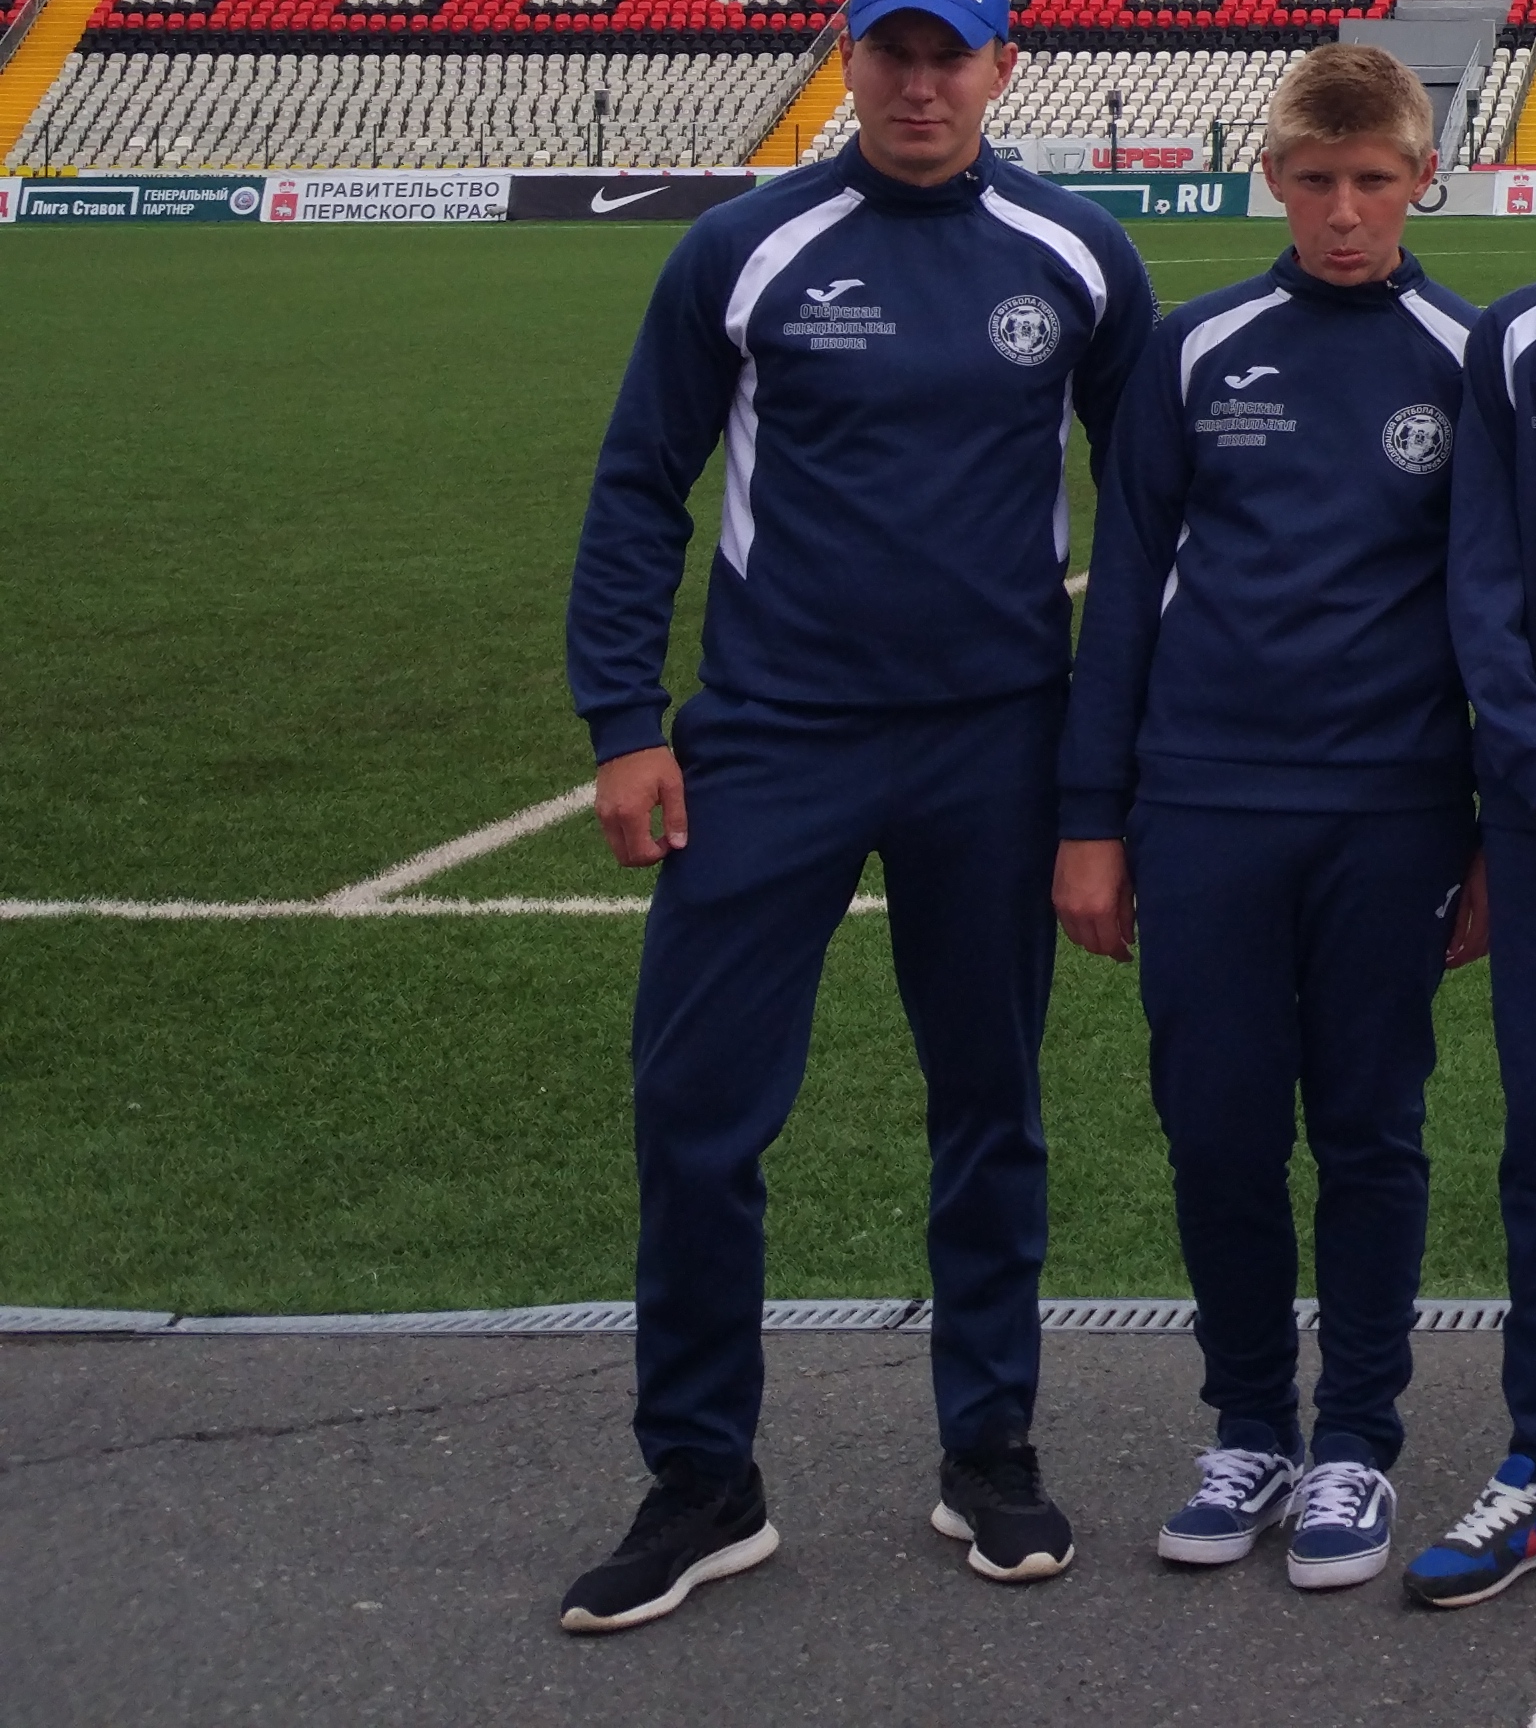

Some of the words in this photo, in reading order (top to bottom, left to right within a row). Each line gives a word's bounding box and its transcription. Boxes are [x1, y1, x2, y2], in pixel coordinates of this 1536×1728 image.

[1092, 147, 1194, 170] ЦЕРБЕР
[144, 187, 230, 201] ГЕНЕРАЛЬНЫЙ
[305, 182, 500, 198] ПРАВИТЕЛЬСТВО
[31, 200, 69, 216] Лига
[72, 199, 126, 216] Ставок
[142, 203, 195, 216] ПАРТНЕР
[303, 203, 436, 220] ПЕРМСКОГО
[800, 302, 881, 321] Очёрская
[997, 296, 1036, 315] ФУТБОЛА
[811, 337, 867, 350] школа
[992, 317, 1018, 360] ФЕДЕРАЦИЯ
[1394, 406, 1434, 422] ФУТБОЛА
